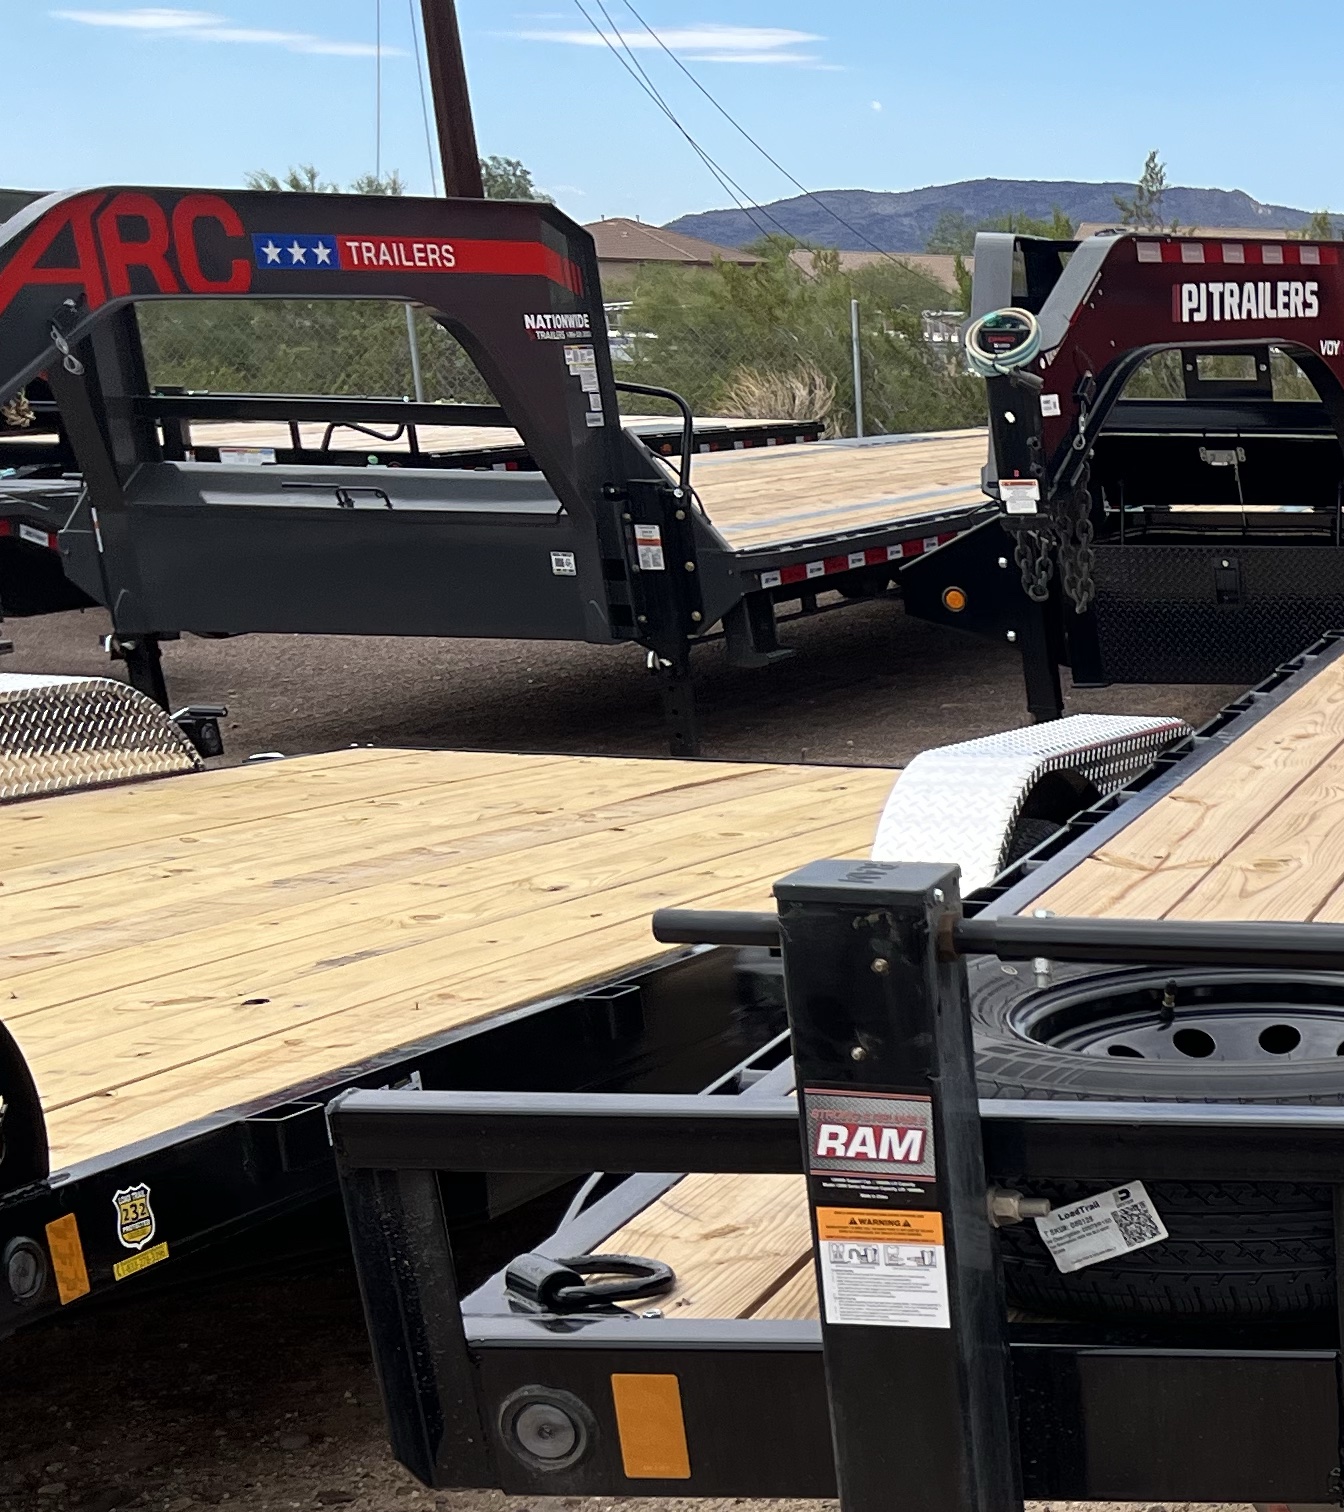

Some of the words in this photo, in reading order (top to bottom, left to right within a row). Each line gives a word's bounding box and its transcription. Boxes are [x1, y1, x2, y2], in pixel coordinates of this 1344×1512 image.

[0, 190, 251, 314] ARC
[346, 241, 455, 267] TRAILERS
[1181, 282, 1207, 322] PJ
[1208, 281, 1319, 321] TRAILERS
[523, 313, 590, 329] NATIONWIDE
[817, 1123, 924, 1162] RAM
[122, 1202, 146, 1222] 232
[1057, 1200, 1101, 1221] LoadTrail
[858, 1218, 901, 1227] WARNING
